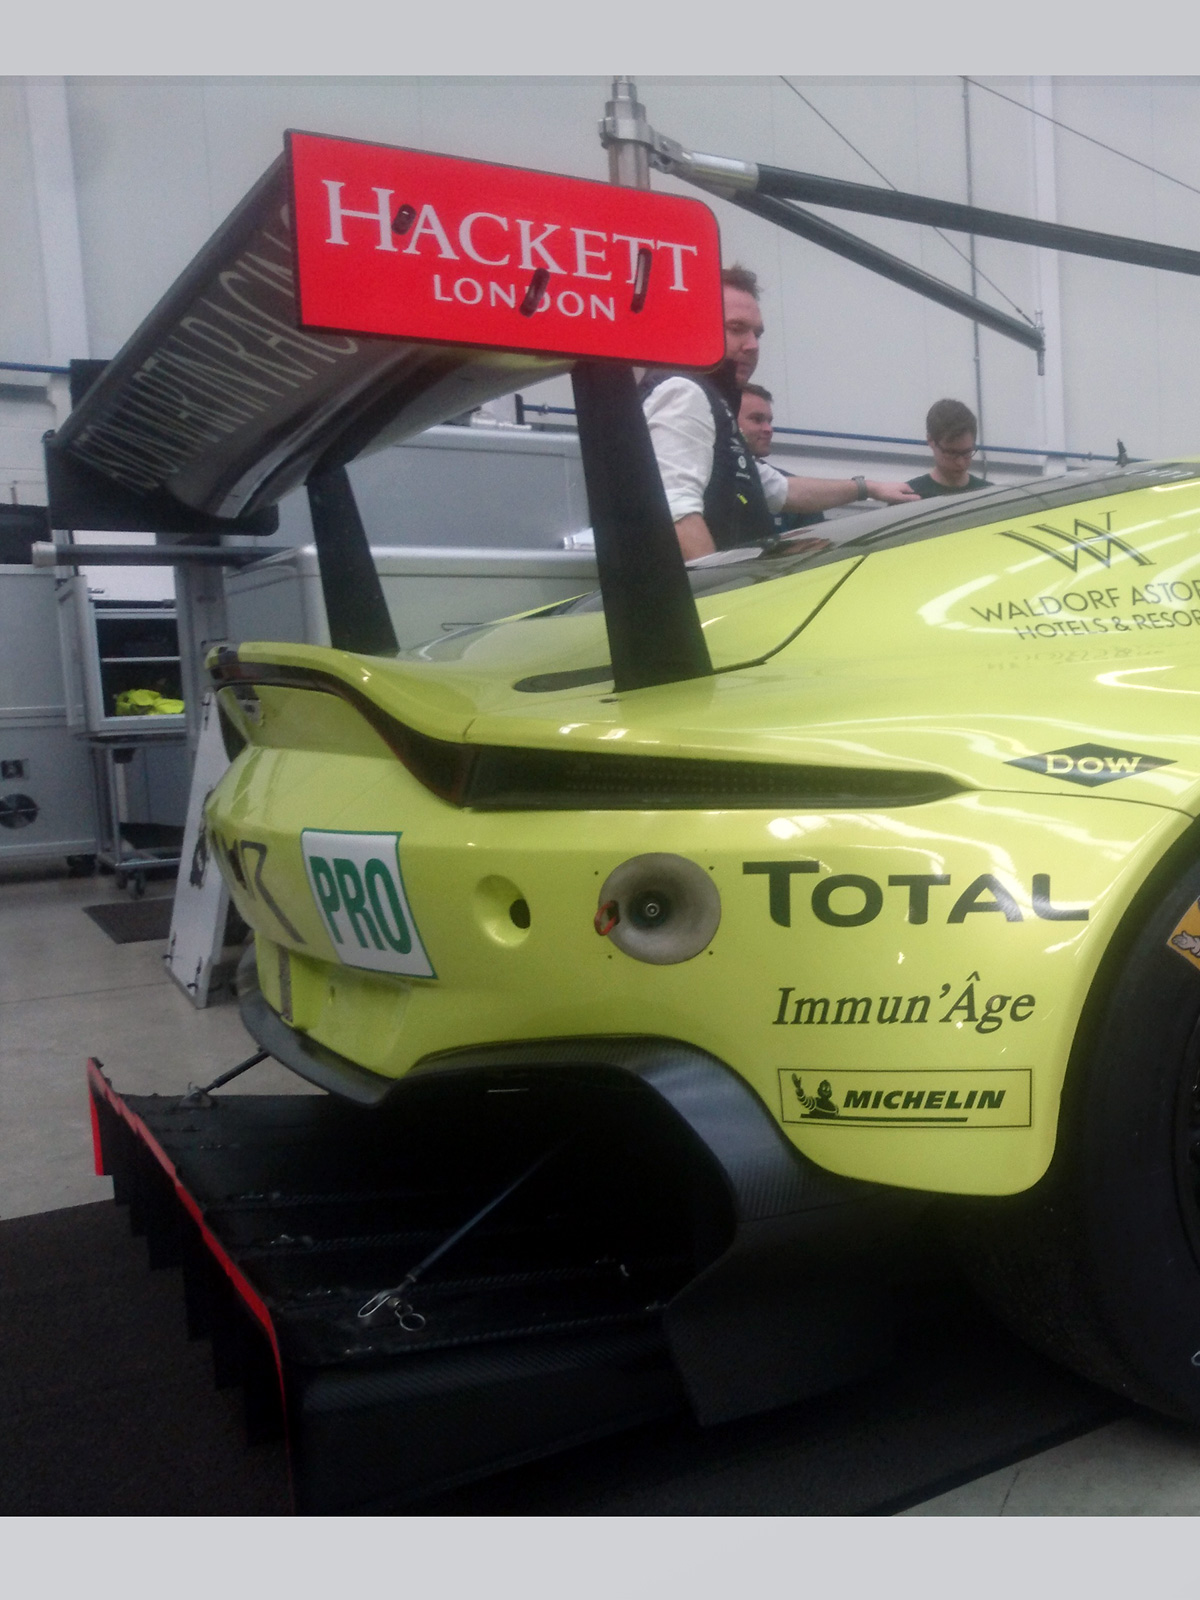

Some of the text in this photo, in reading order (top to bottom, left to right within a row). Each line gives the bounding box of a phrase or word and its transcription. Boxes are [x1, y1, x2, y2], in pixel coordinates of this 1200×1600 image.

[322, 179, 698, 292] HACKETT
[433, 274, 615, 321] LONDON
[970, 588, 1122, 623] WALDORF
[1013, 617, 1108, 641] HOTELS
[1111, 616, 1132, 632] &
[309, 855, 413, 955] PRO
[742, 860, 1090, 928] TOTAL
[843, 1089, 1007, 1110] MICHELIN
